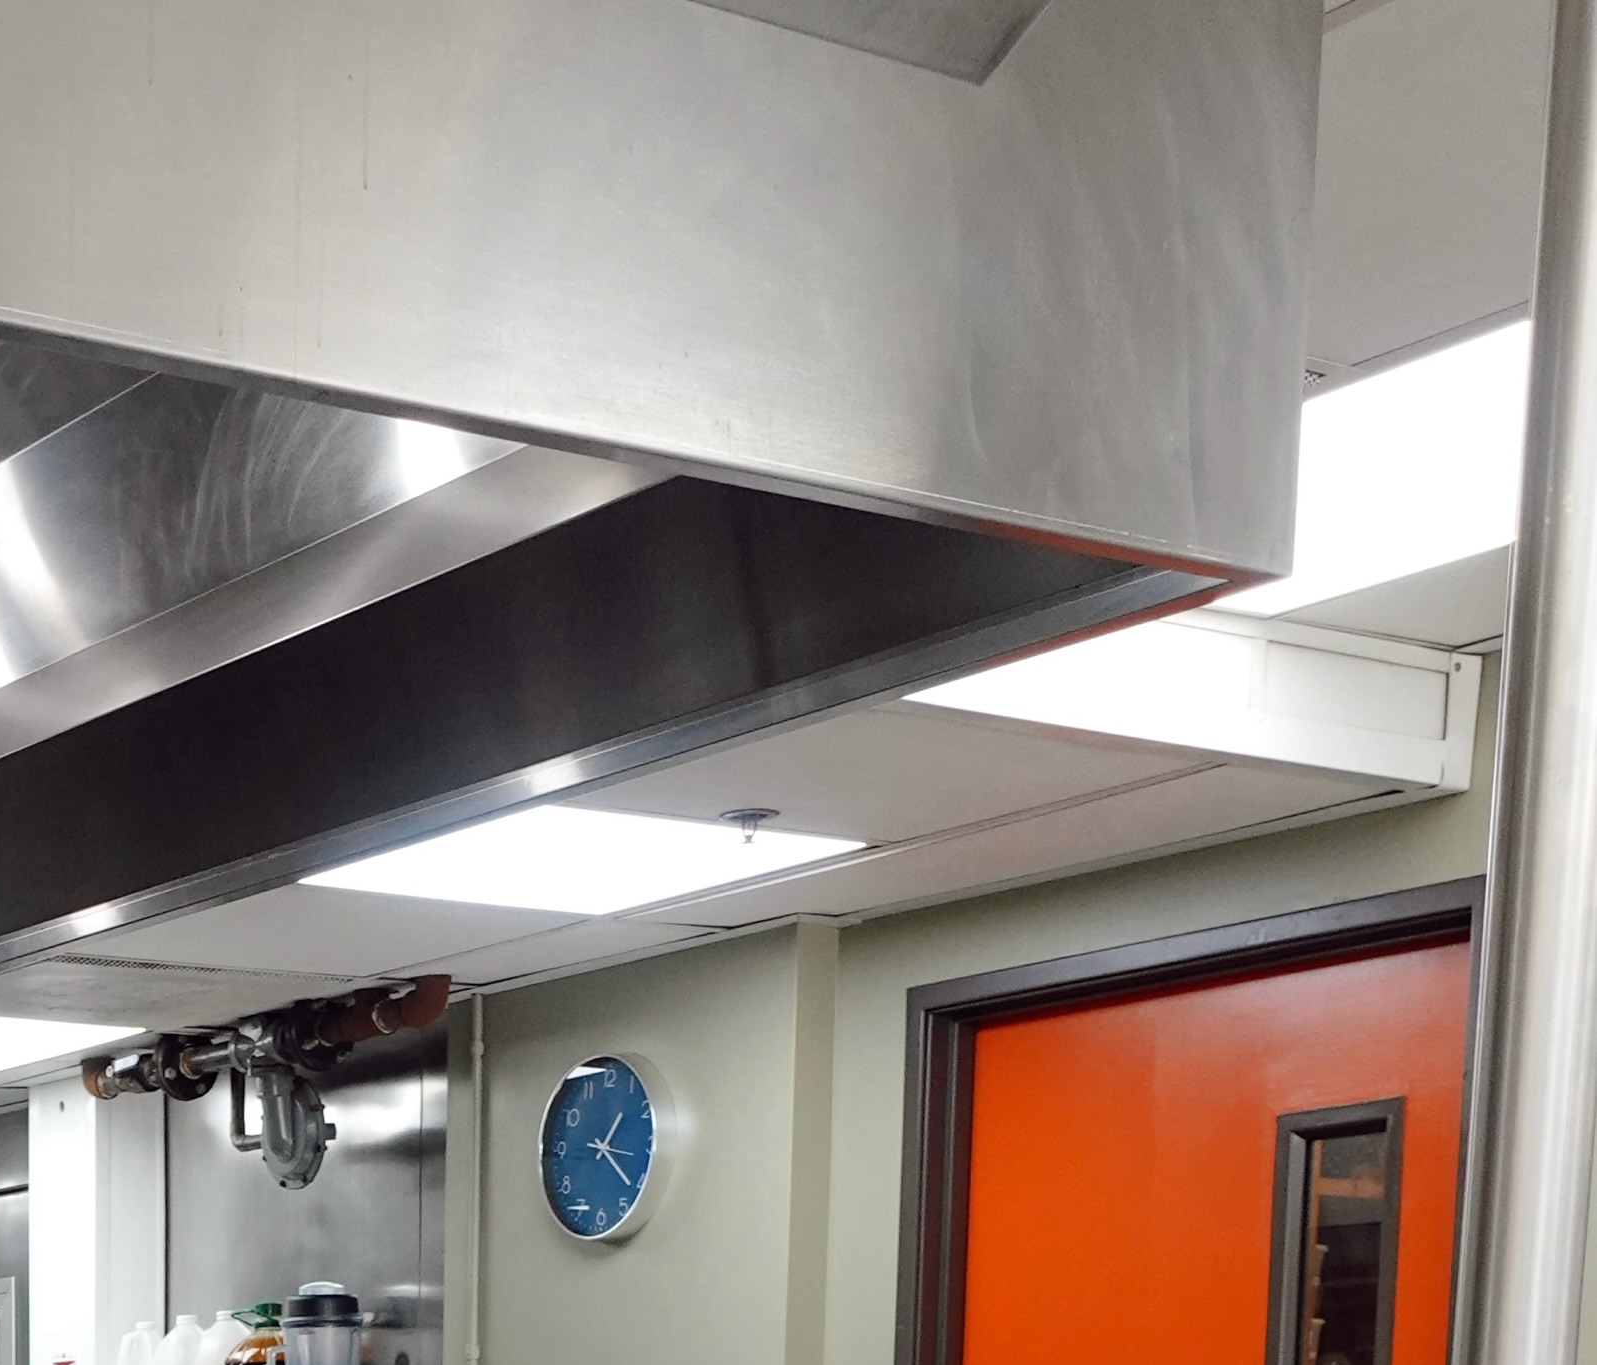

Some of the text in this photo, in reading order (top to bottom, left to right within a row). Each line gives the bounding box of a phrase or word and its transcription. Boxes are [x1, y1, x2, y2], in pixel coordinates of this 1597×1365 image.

[604, 1068, 617, 1088] 12
[629, 1075, 635, 1094] 1
[583, 1081, 595, 1100] 11
[564, 1108, 581, 1128] 10
[640, 1099, 651, 1119] 2
[556, 1141, 567, 1160] 9
[560, 1175, 571, 1195] 8
[574, 1198, 587, 1221] 7
[595, 1207, 607, 1226] 6
[618, 1197, 629, 1217] 5
